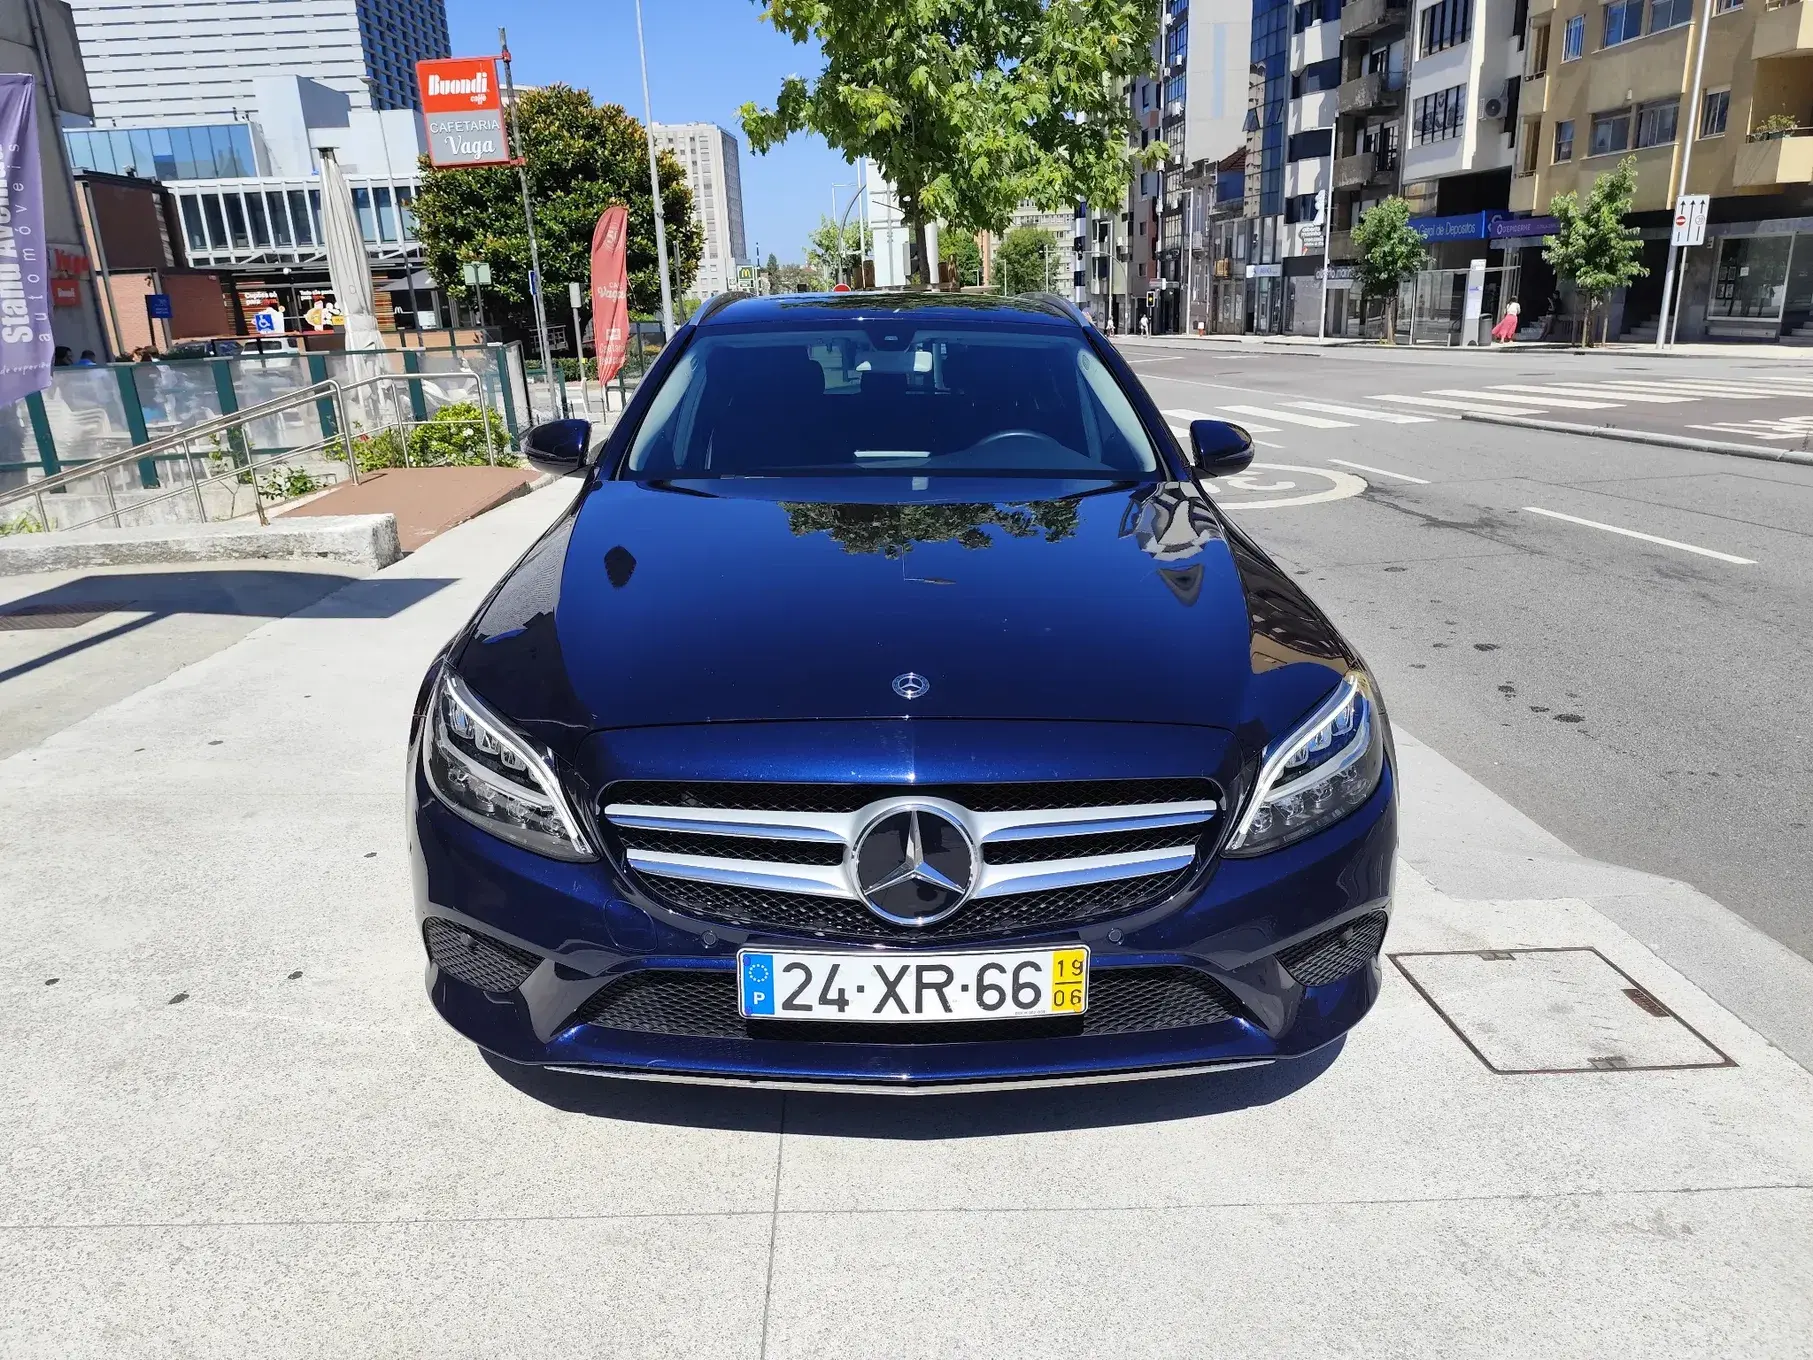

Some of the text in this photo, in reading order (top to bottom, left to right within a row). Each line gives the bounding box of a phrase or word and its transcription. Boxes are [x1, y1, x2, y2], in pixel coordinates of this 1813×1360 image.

[428, 72, 487, 96] Buondi
[430, 120, 500, 133] CAFETARIA
[444, 135, 496, 159] Vaga
[1056, 959, 1084, 978] 19
[753, 991, 766, 1005] P
[1052, 988, 1083, 1007] 06
